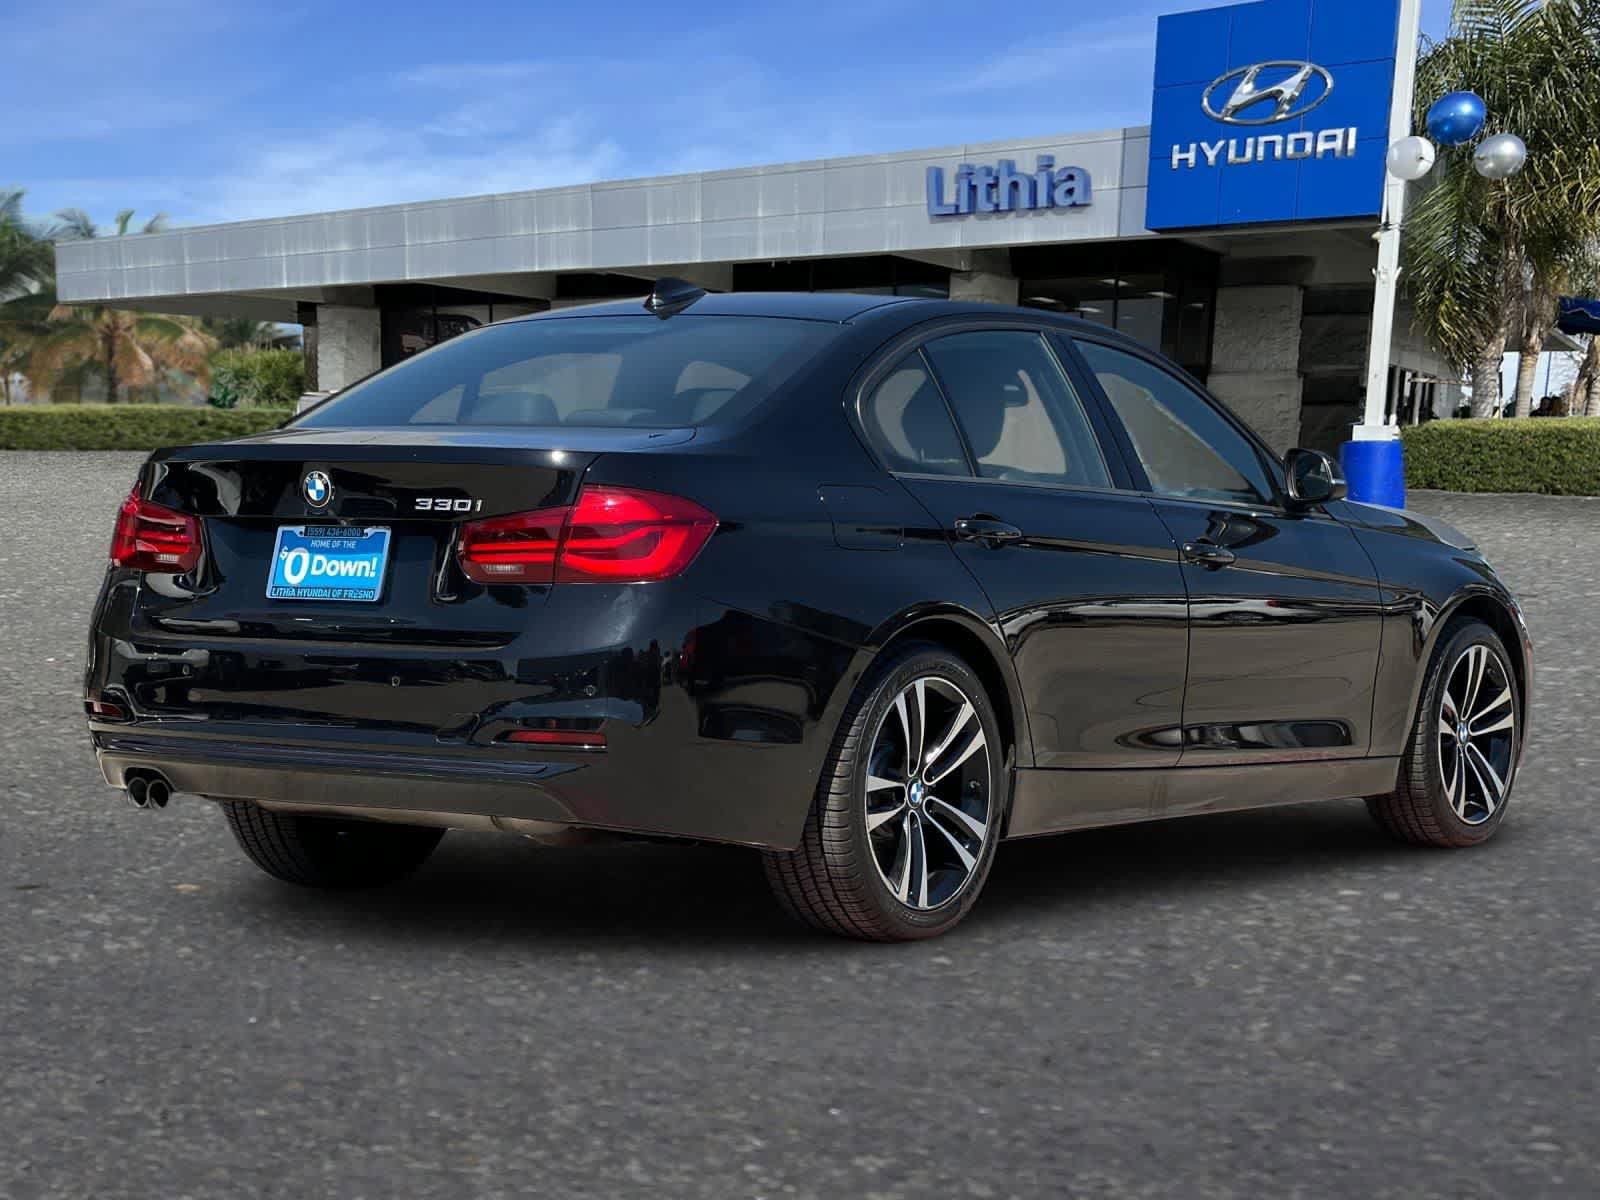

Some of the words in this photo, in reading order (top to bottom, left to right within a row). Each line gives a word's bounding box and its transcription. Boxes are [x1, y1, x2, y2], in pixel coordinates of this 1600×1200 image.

[1171, 127, 1358, 170] HYUNDAI
[927, 155, 1092, 217] Lithia
[310, 539, 331, 548] HOME
[331, 540, 341, 549] OF
[342, 540, 357, 549] THE
[311, 555, 378, 578] Down!
[271, 587, 296, 598] LITHIA
[296, 588, 330, 598] HYUNDAI
[330, 589, 341, 598] OF
[343, 589, 375, 599] FRESNO
